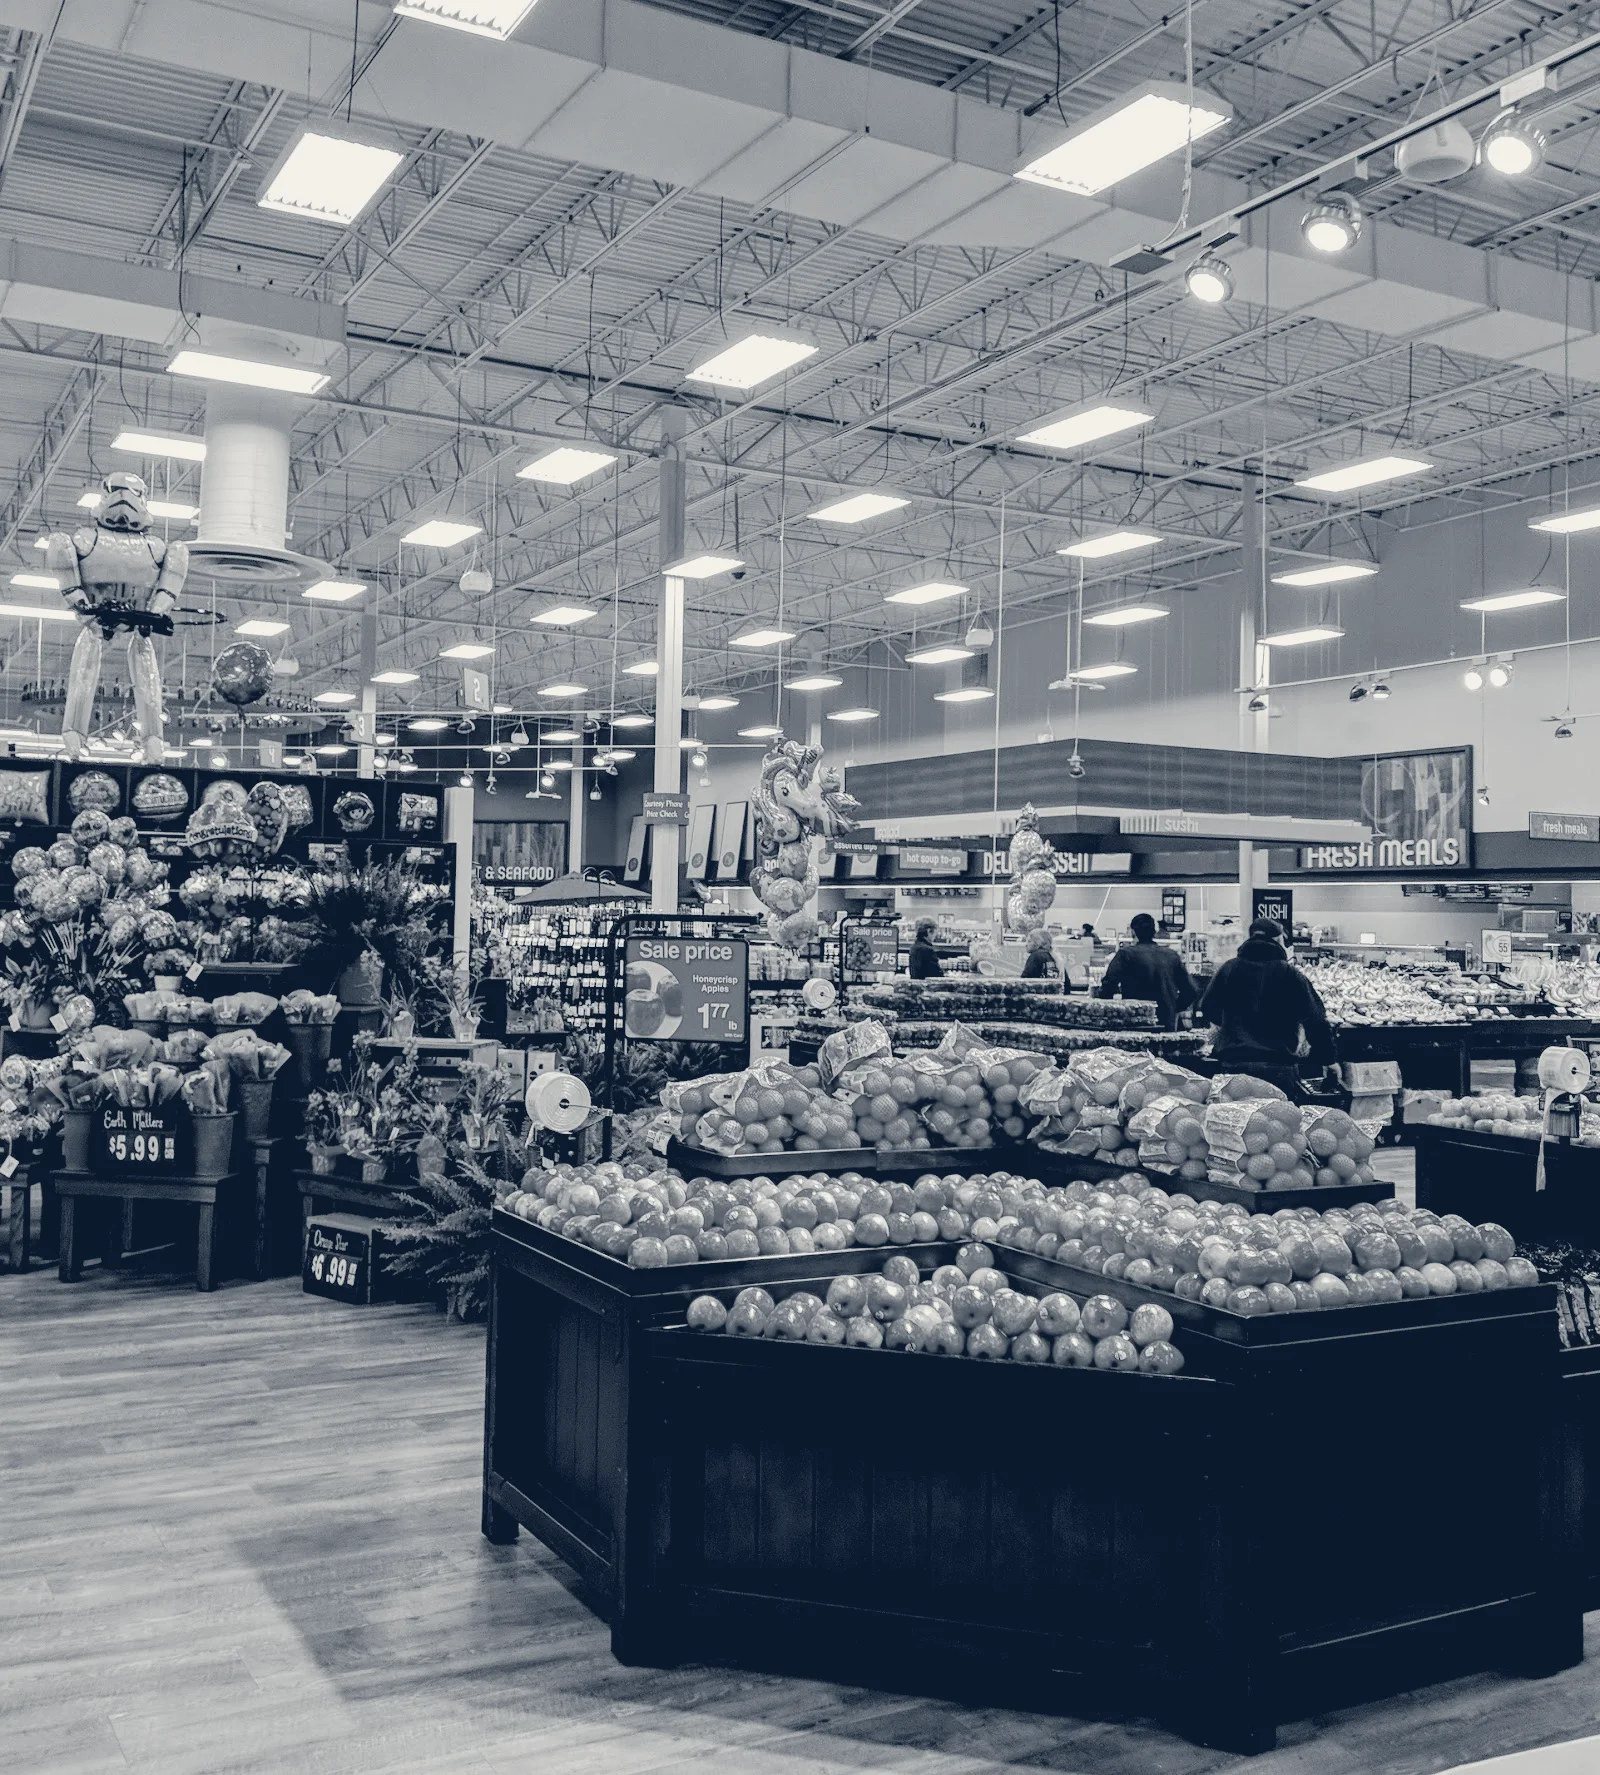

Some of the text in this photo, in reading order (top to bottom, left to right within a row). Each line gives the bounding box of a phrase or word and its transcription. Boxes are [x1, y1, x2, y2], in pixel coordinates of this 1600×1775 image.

[473, 677, 482, 702] 2
[358, 716, 365, 737] 3
[268, 746, 275, 763] 4
[666, 800, 684, 808] Phone
[646, 810, 659, 818] Price
[660, 810, 678, 818] Check
[1164, 817, 1199, 833] sushi
[1543, 820, 1588, 835] fresh meals
[906, 852, 961, 867] hot soup to-go
[1307, 838, 1459, 868] FRESH MEALS
[485, 866, 495, 880] &
[498, 866, 554, 881] SEAFOOD
[1258, 903, 1288, 920] SUSHI
[853, 927, 893, 938] Sale price
[639, 940, 733, 964] Sale price
[872, 951, 896, 966] 2/$5
[692, 974, 738, 986] Honeycrisp
[701, 984, 729, 994] Apples
[728, 1020, 738, 1030] lb
[103, 1110, 164, 1131] Earth Matters
[109, 1134, 159, 1162] $5.99
[311, 1253, 347, 1286] $6.99
